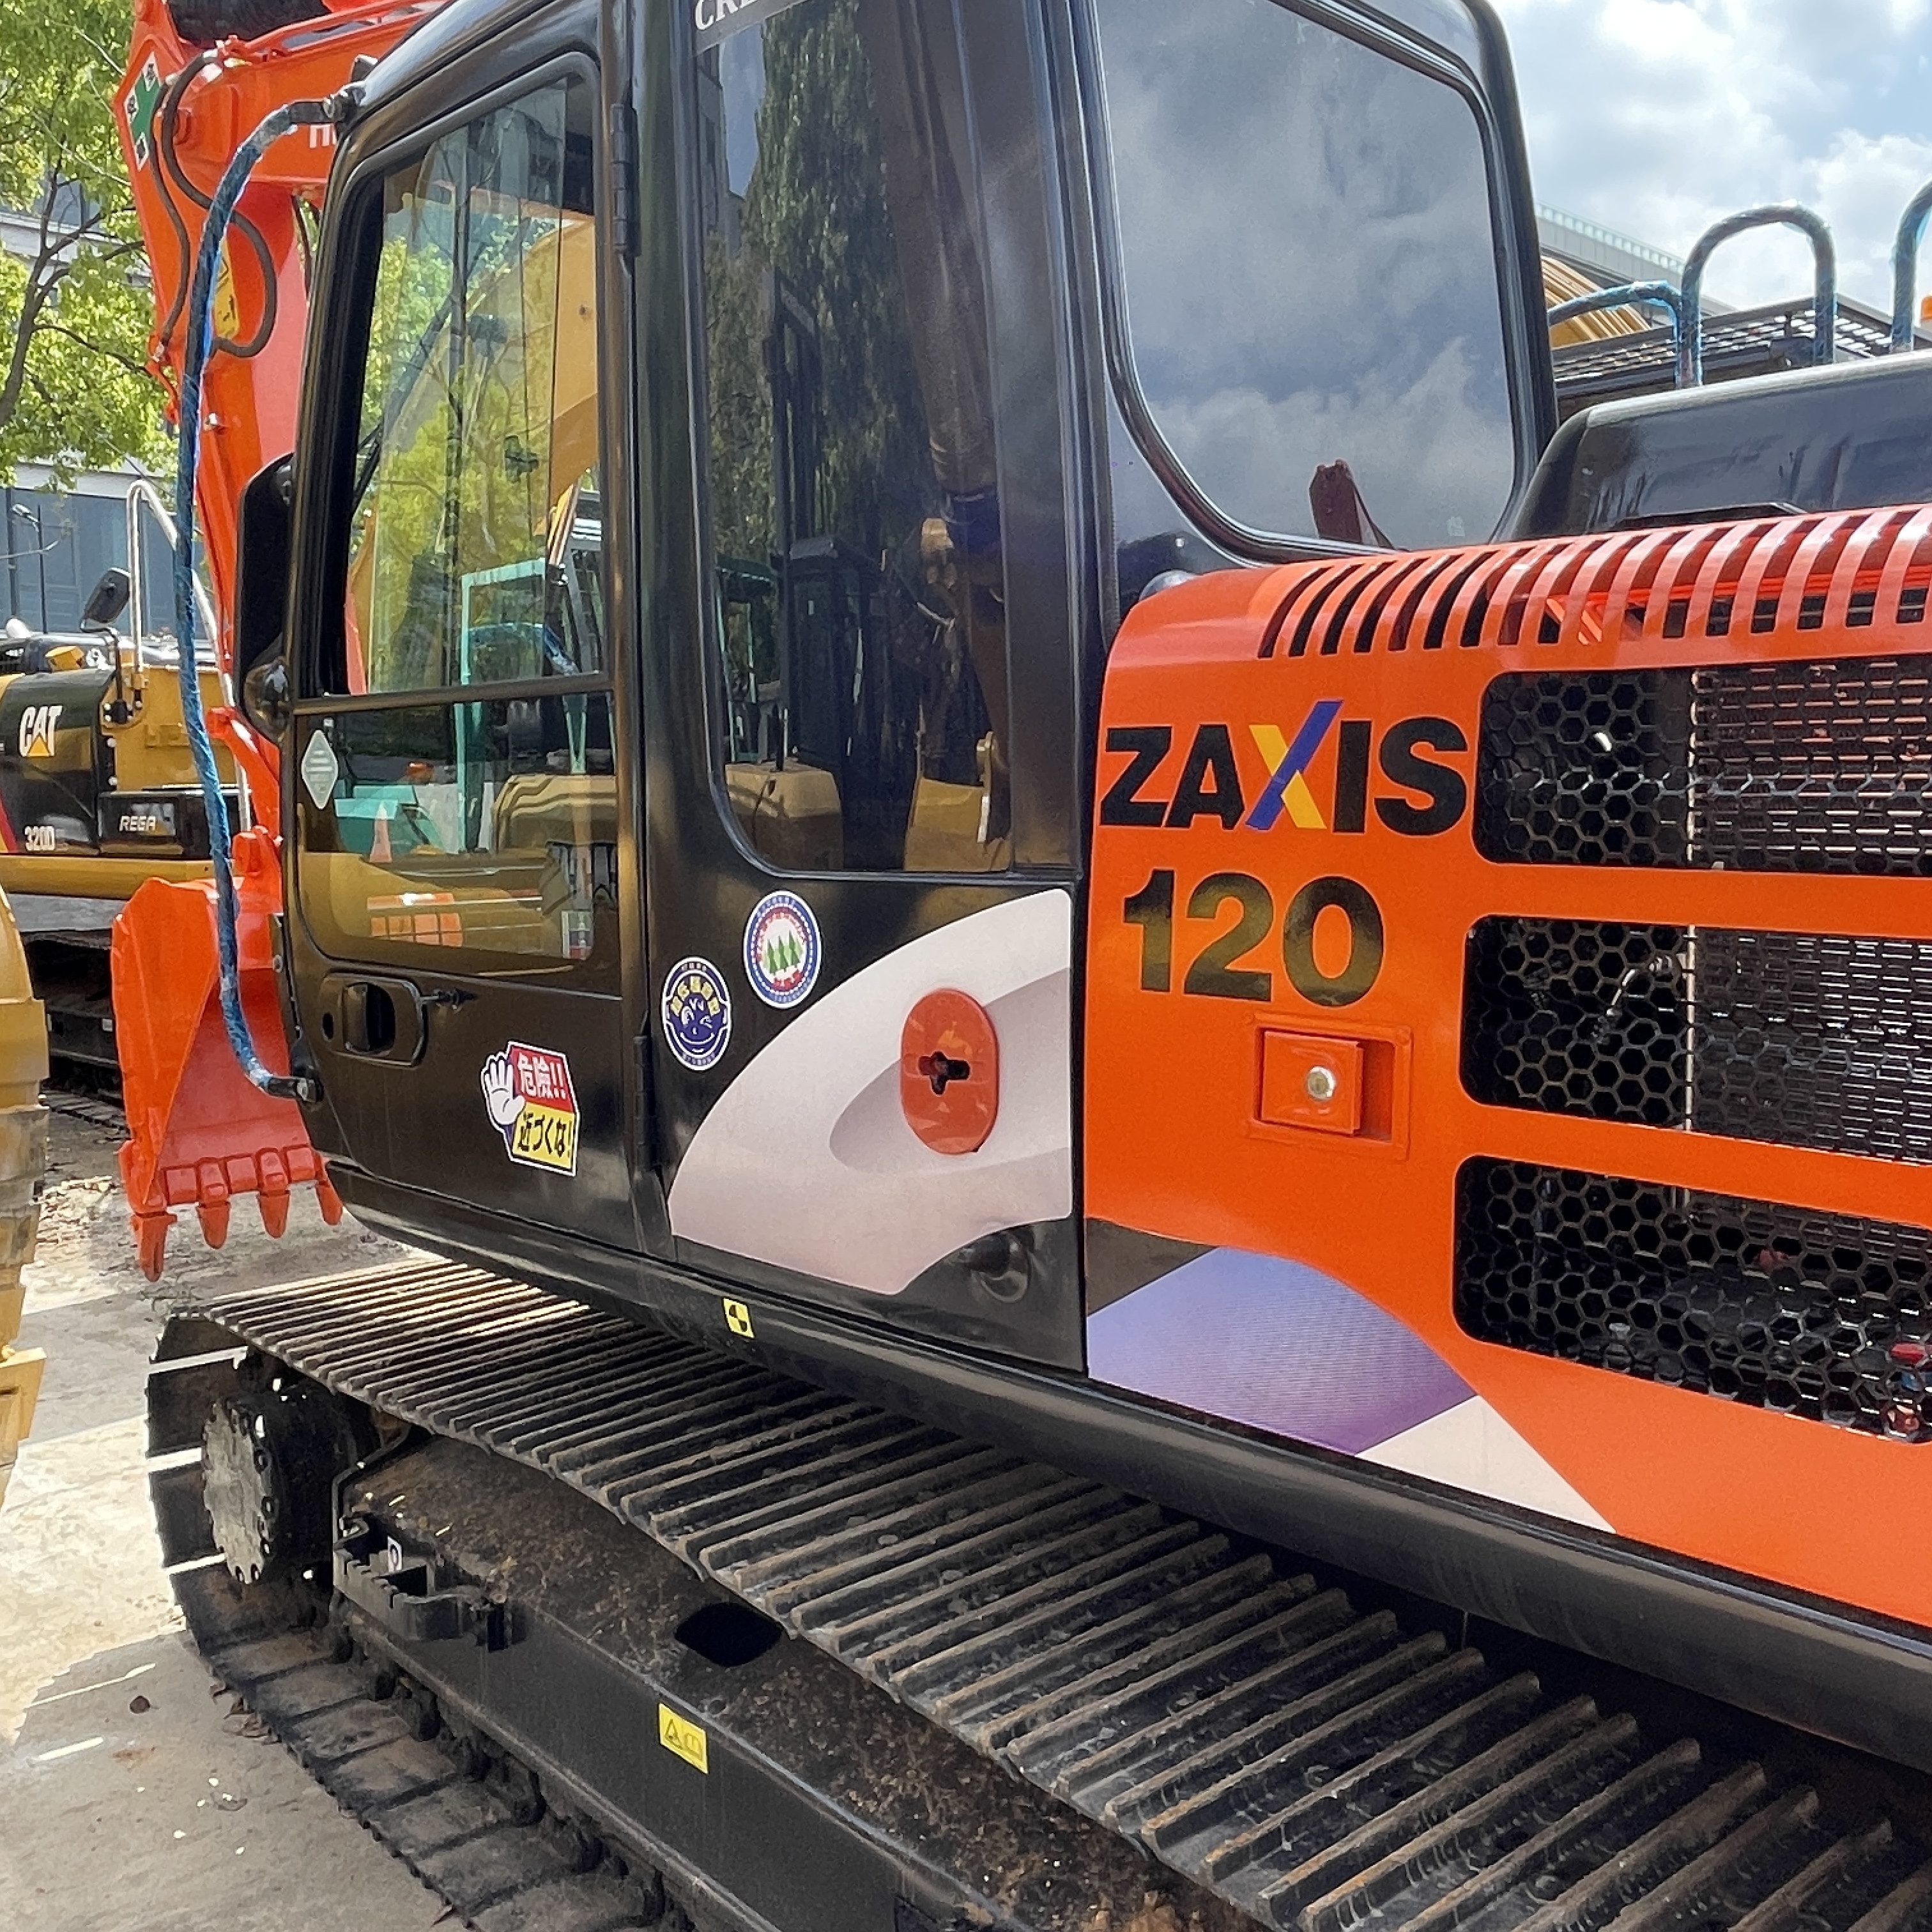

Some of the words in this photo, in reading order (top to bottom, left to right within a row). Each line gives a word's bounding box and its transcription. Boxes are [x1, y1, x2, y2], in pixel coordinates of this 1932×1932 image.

[20, 706, 62, 756] CAT
[1100, 700, 1468, 836] ZAXIS
[1123, 869, 1384, 1008] 120
